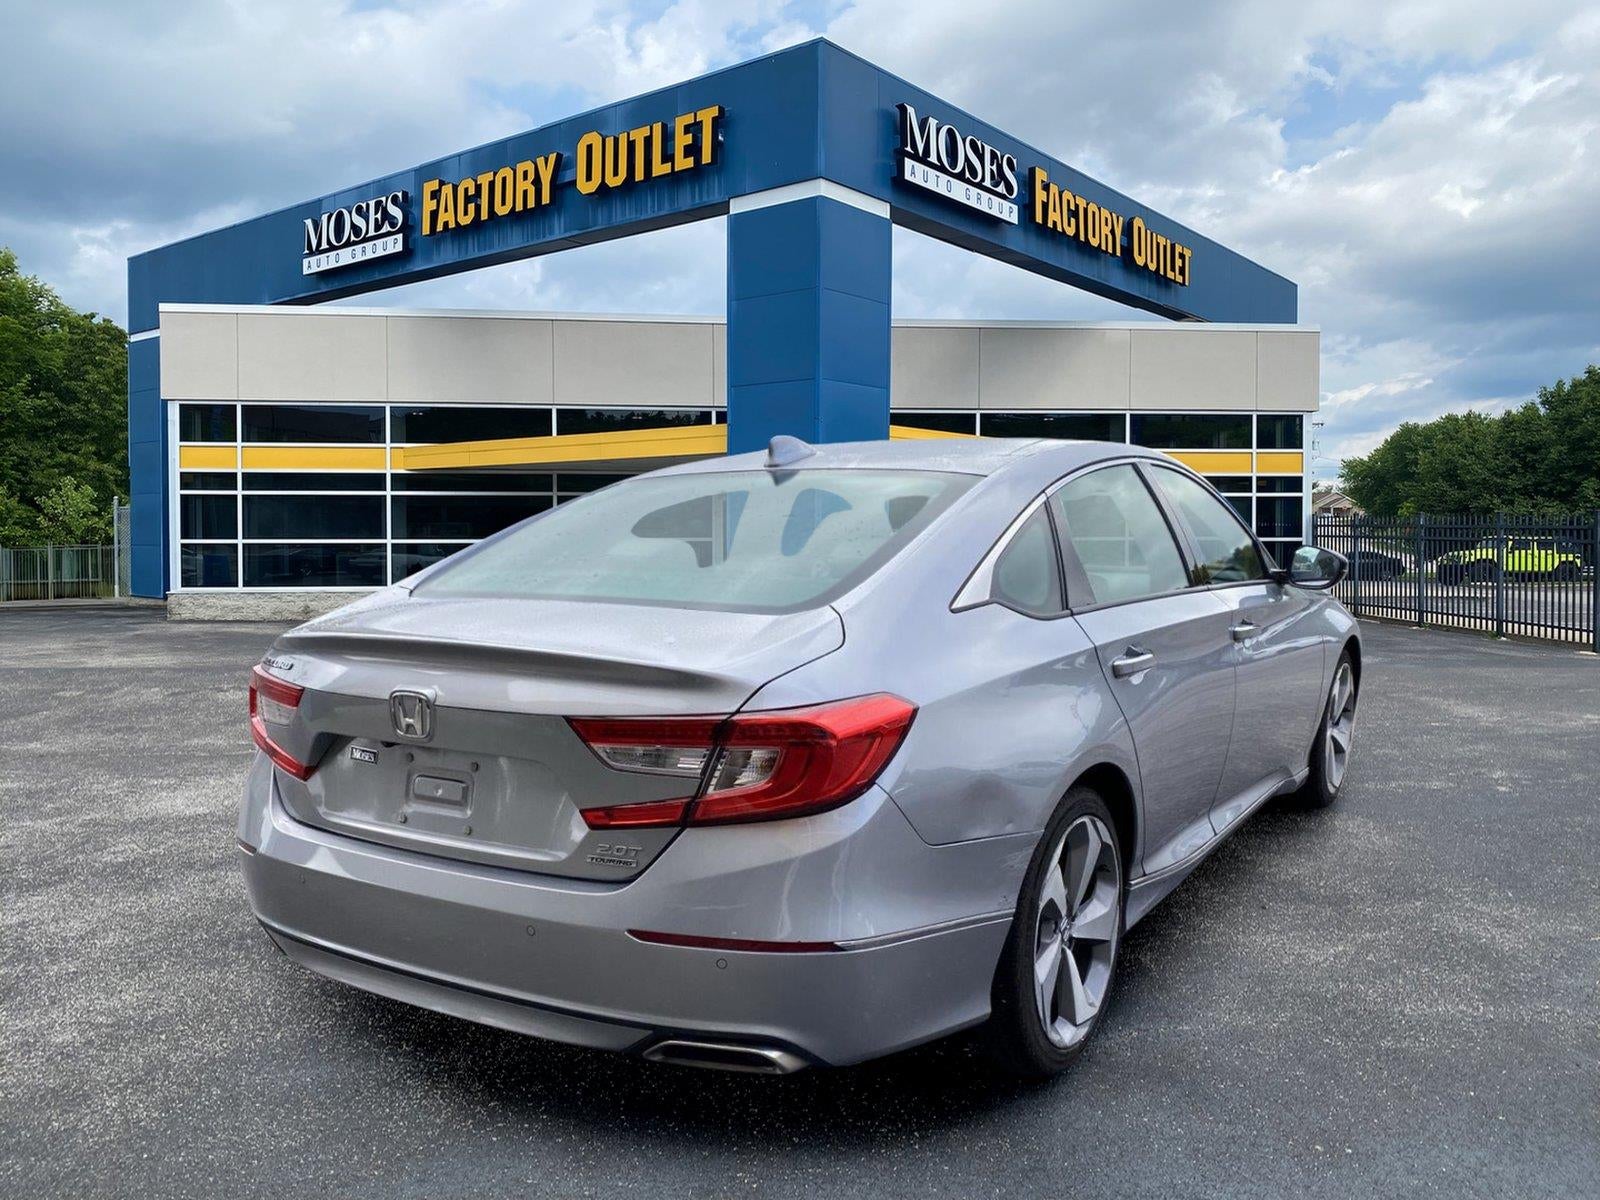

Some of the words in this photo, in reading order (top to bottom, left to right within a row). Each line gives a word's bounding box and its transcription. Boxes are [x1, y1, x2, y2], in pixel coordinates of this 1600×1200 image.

[421, 152, 558, 236] FACTORY
[575, 104, 721, 196] OUTLET
[902, 102, 1019, 200] MOSES
[302, 191, 404, 255] MOSES
[909, 164, 953, 194] AUTO
[964, 188, 1015, 219] GROUP
[306, 252, 341, 271] AUTO
[350, 236, 400, 260] GROUP
[1034, 166, 1124, 257] FACTORY
[1131, 216, 1193, 287] OUTLET
[588, 856, 634, 867] TOURING
